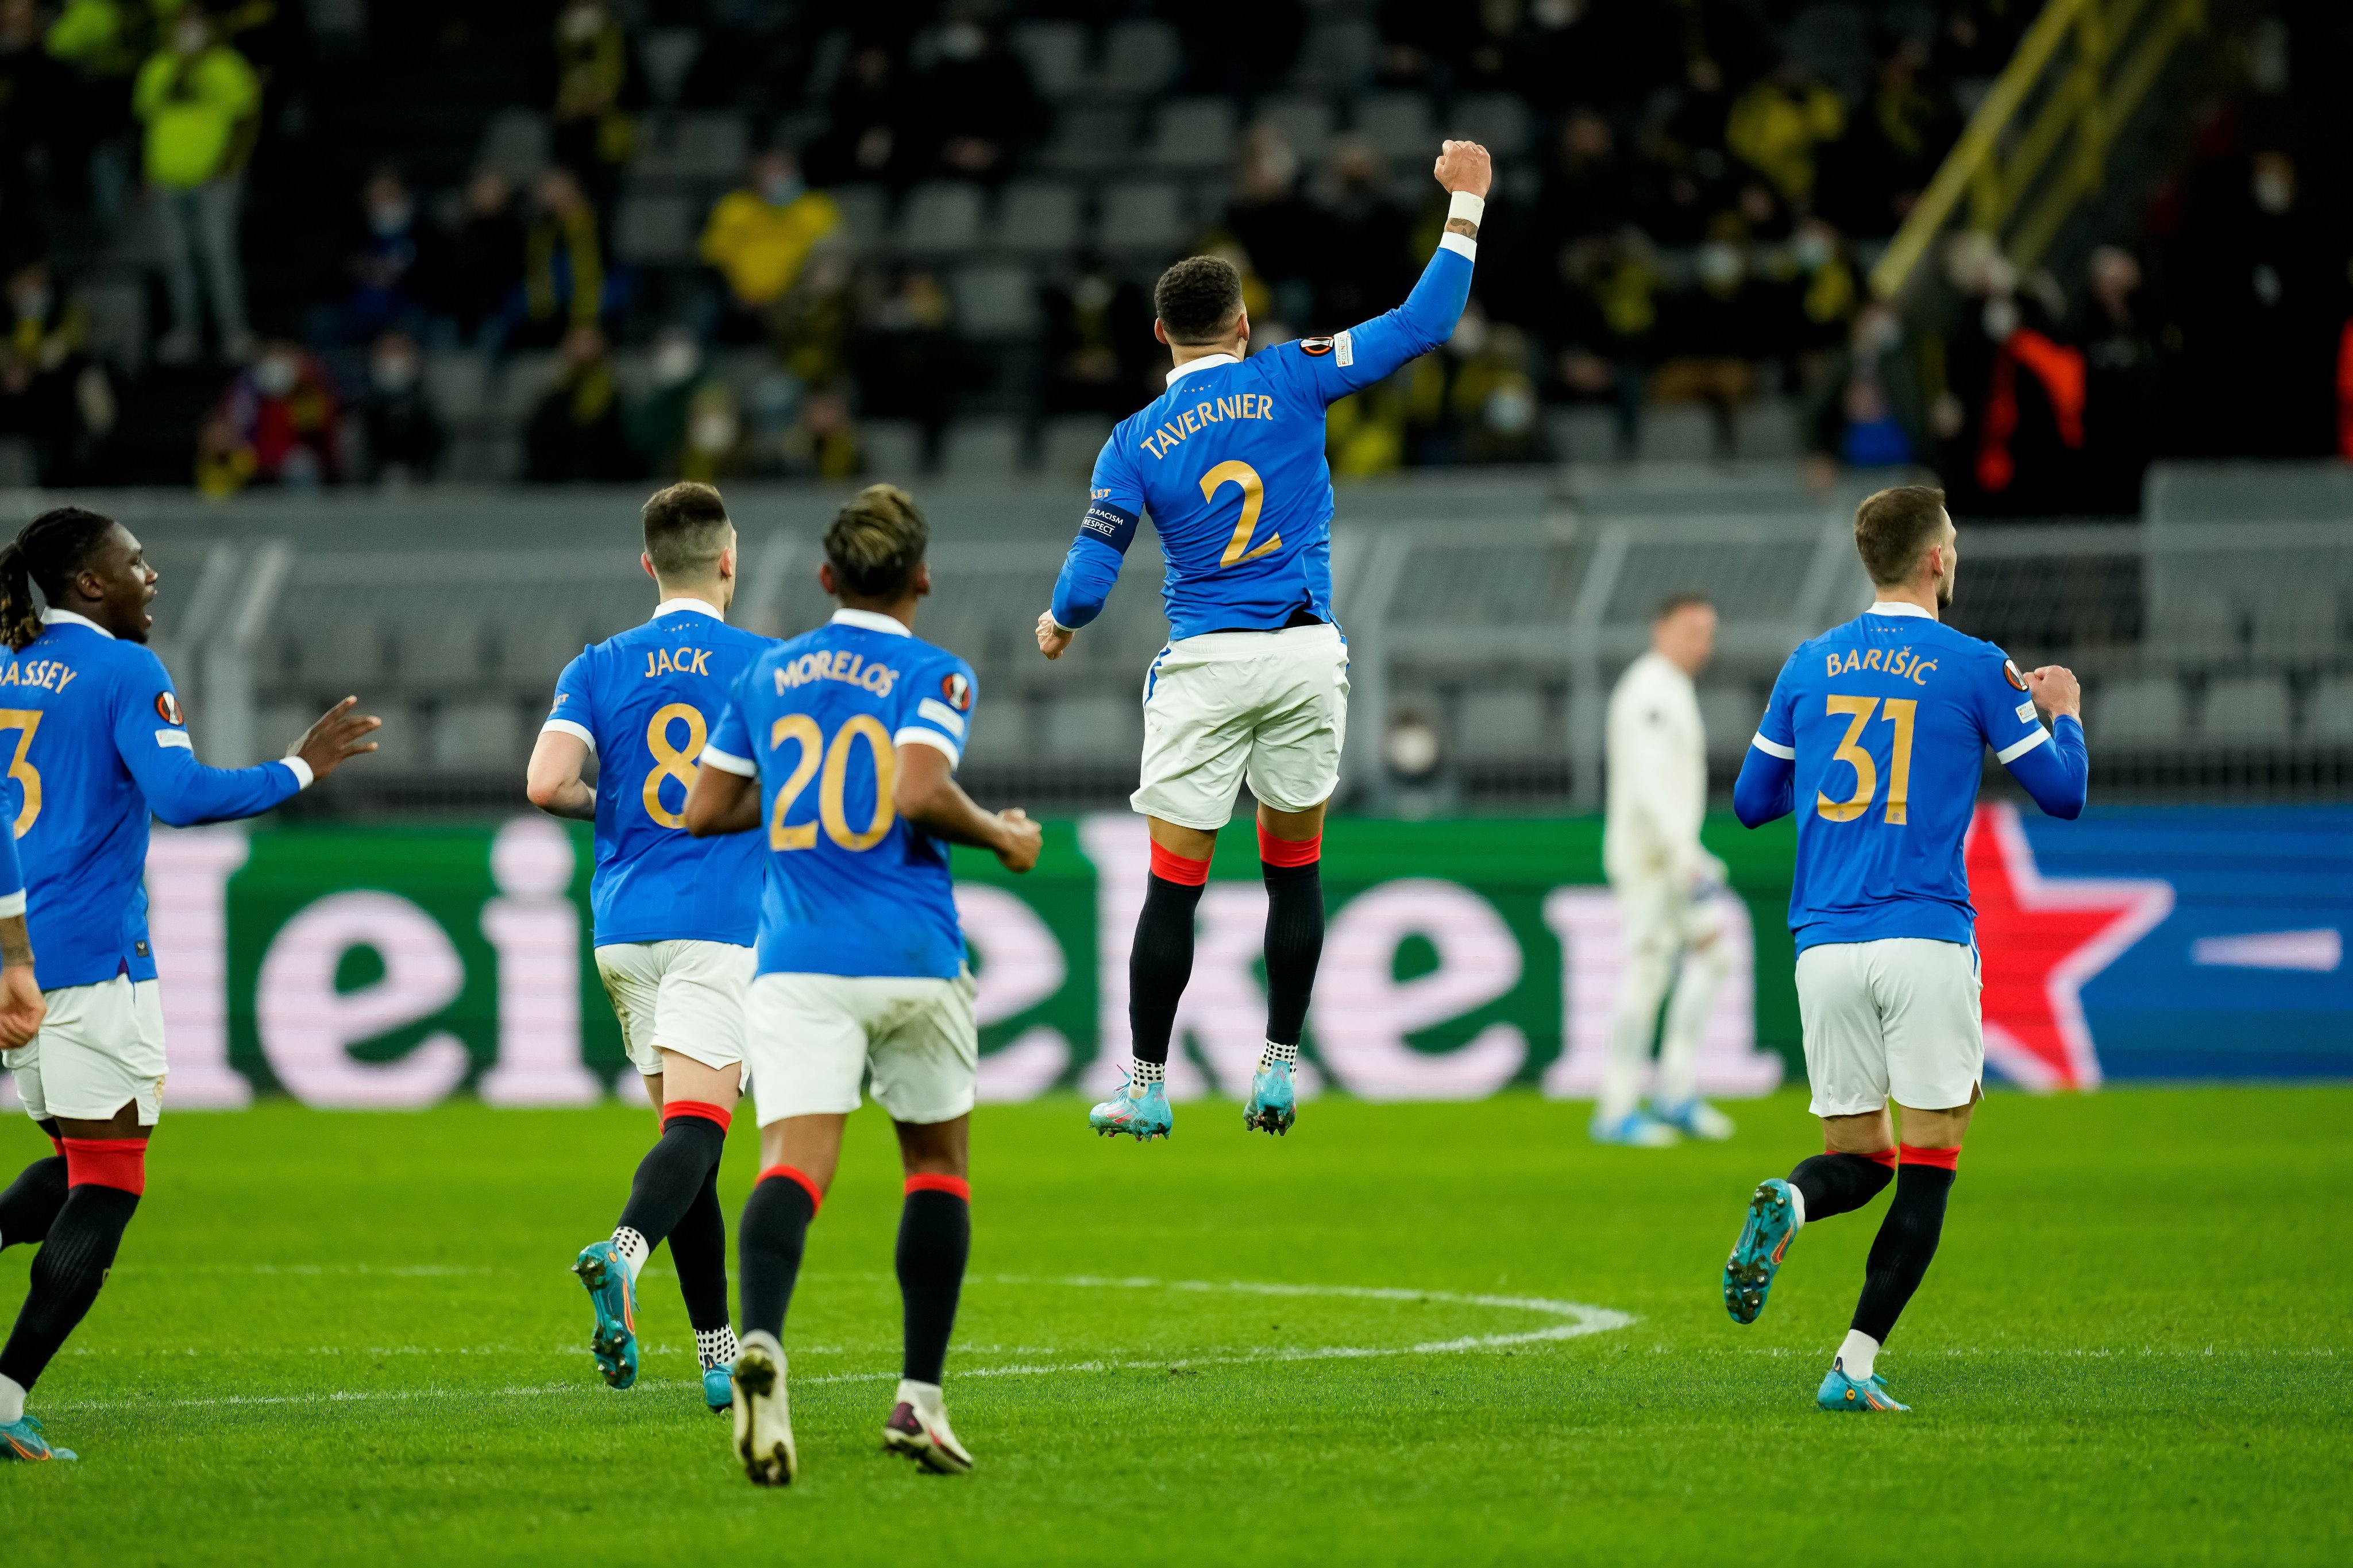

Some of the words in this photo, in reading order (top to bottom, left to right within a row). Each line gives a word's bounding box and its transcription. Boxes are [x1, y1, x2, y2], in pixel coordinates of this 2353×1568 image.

[1141, 393, 1273, 460] TAVERNIER
[1083, 518, 1114, 534] RESPECT
[1095, 509, 1124, 526] RACISM
[1199, 460, 1282, 568] 2
[0, 660, 78, 694] ASSEY
[645, 647, 713, 678] JACK
[774, 650, 900, 698] MORELOS
[1826, 646, 1938, 686] BARIŠIĆ
[642, 702, 708, 829] 8
[770, 714, 896, 852] 20
[1817, 694, 1918, 825] 31
